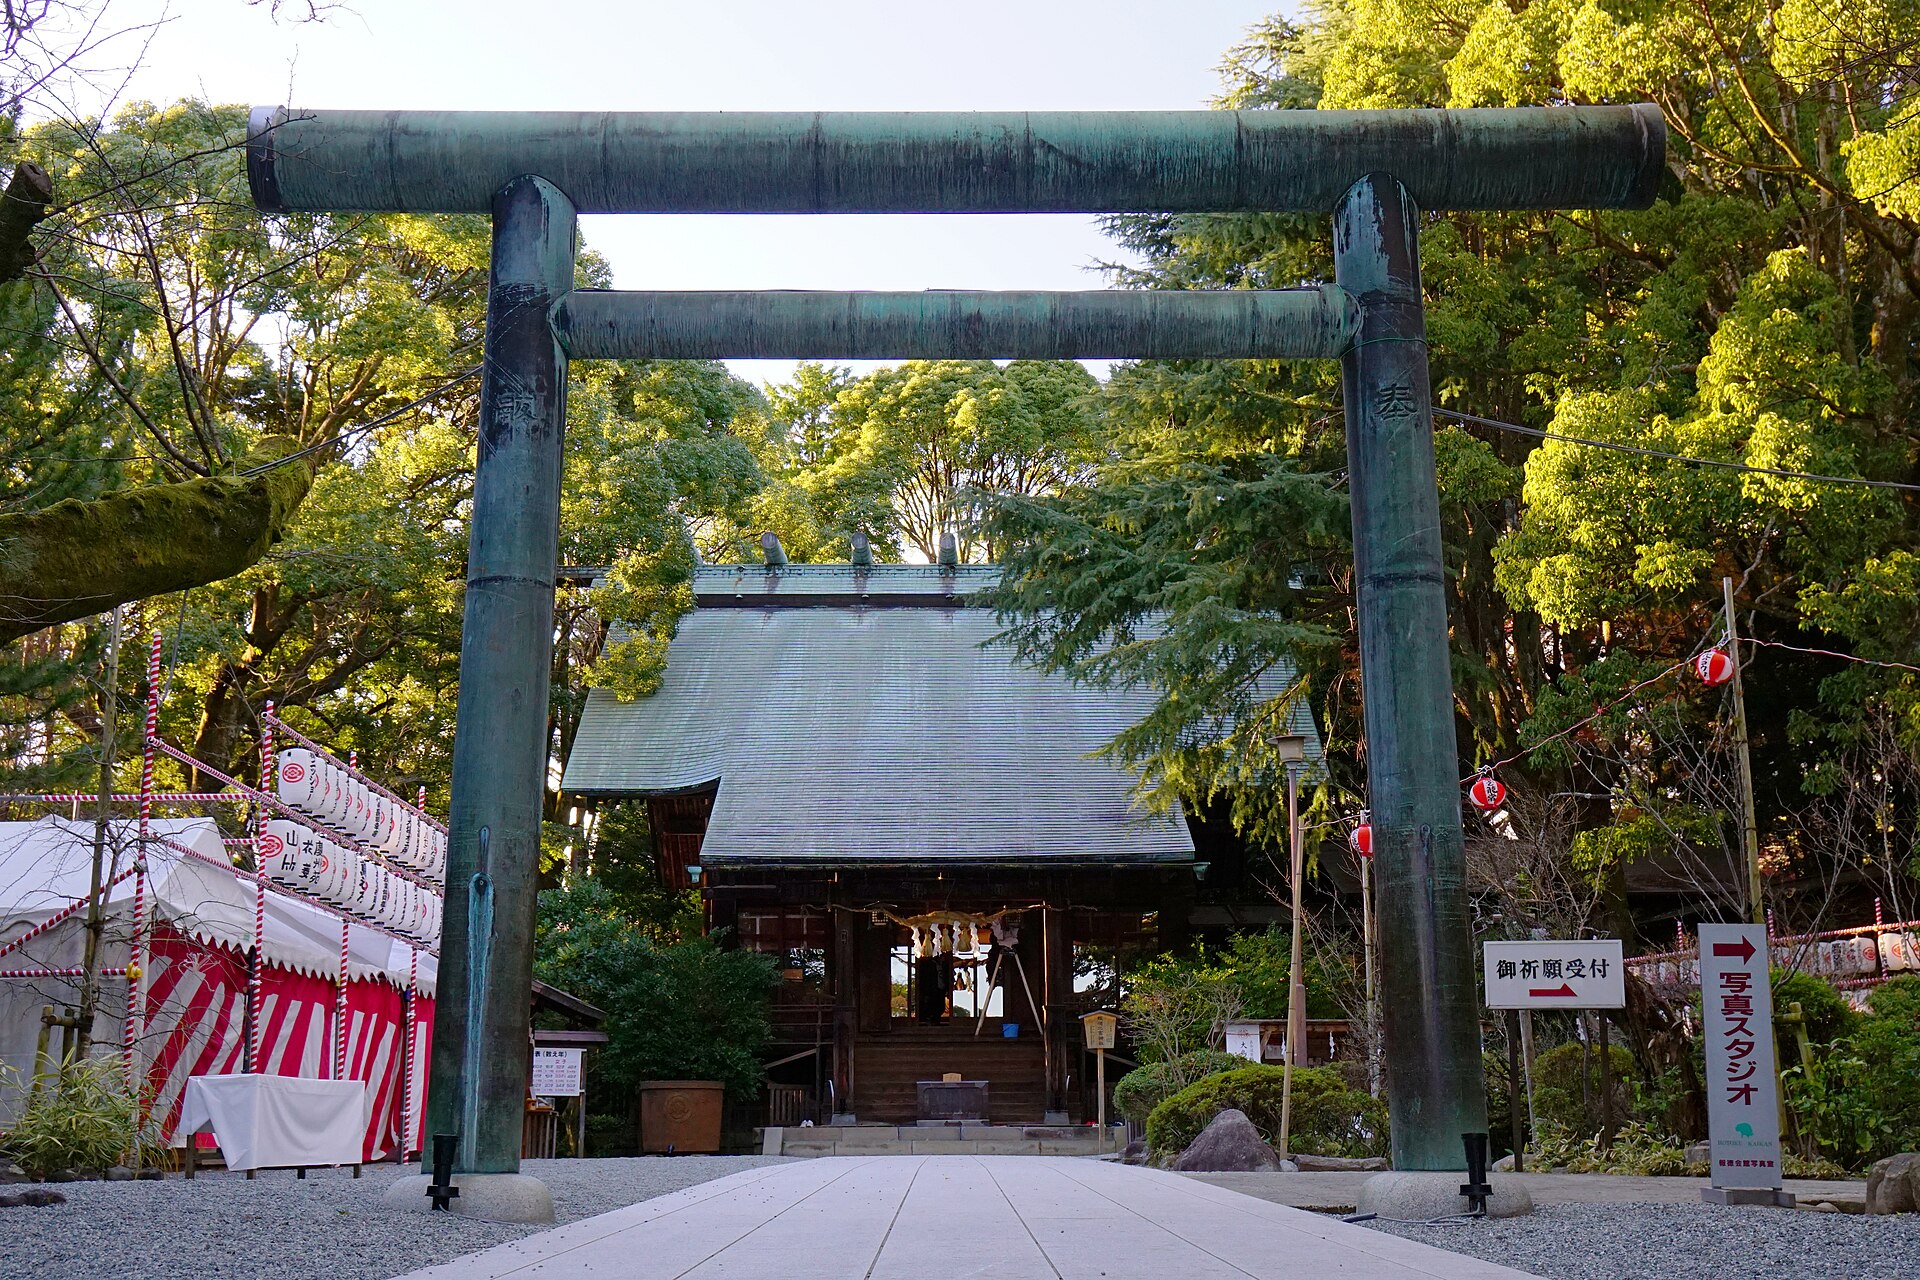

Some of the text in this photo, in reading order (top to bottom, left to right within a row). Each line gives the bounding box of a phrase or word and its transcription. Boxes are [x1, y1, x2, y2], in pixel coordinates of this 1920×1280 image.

[1375, 383, 1418, 421] 奉
[1496, 958, 1610, 980] 御祈願受付
[1719, 972, 1758, 1106] 写真スタジオ
